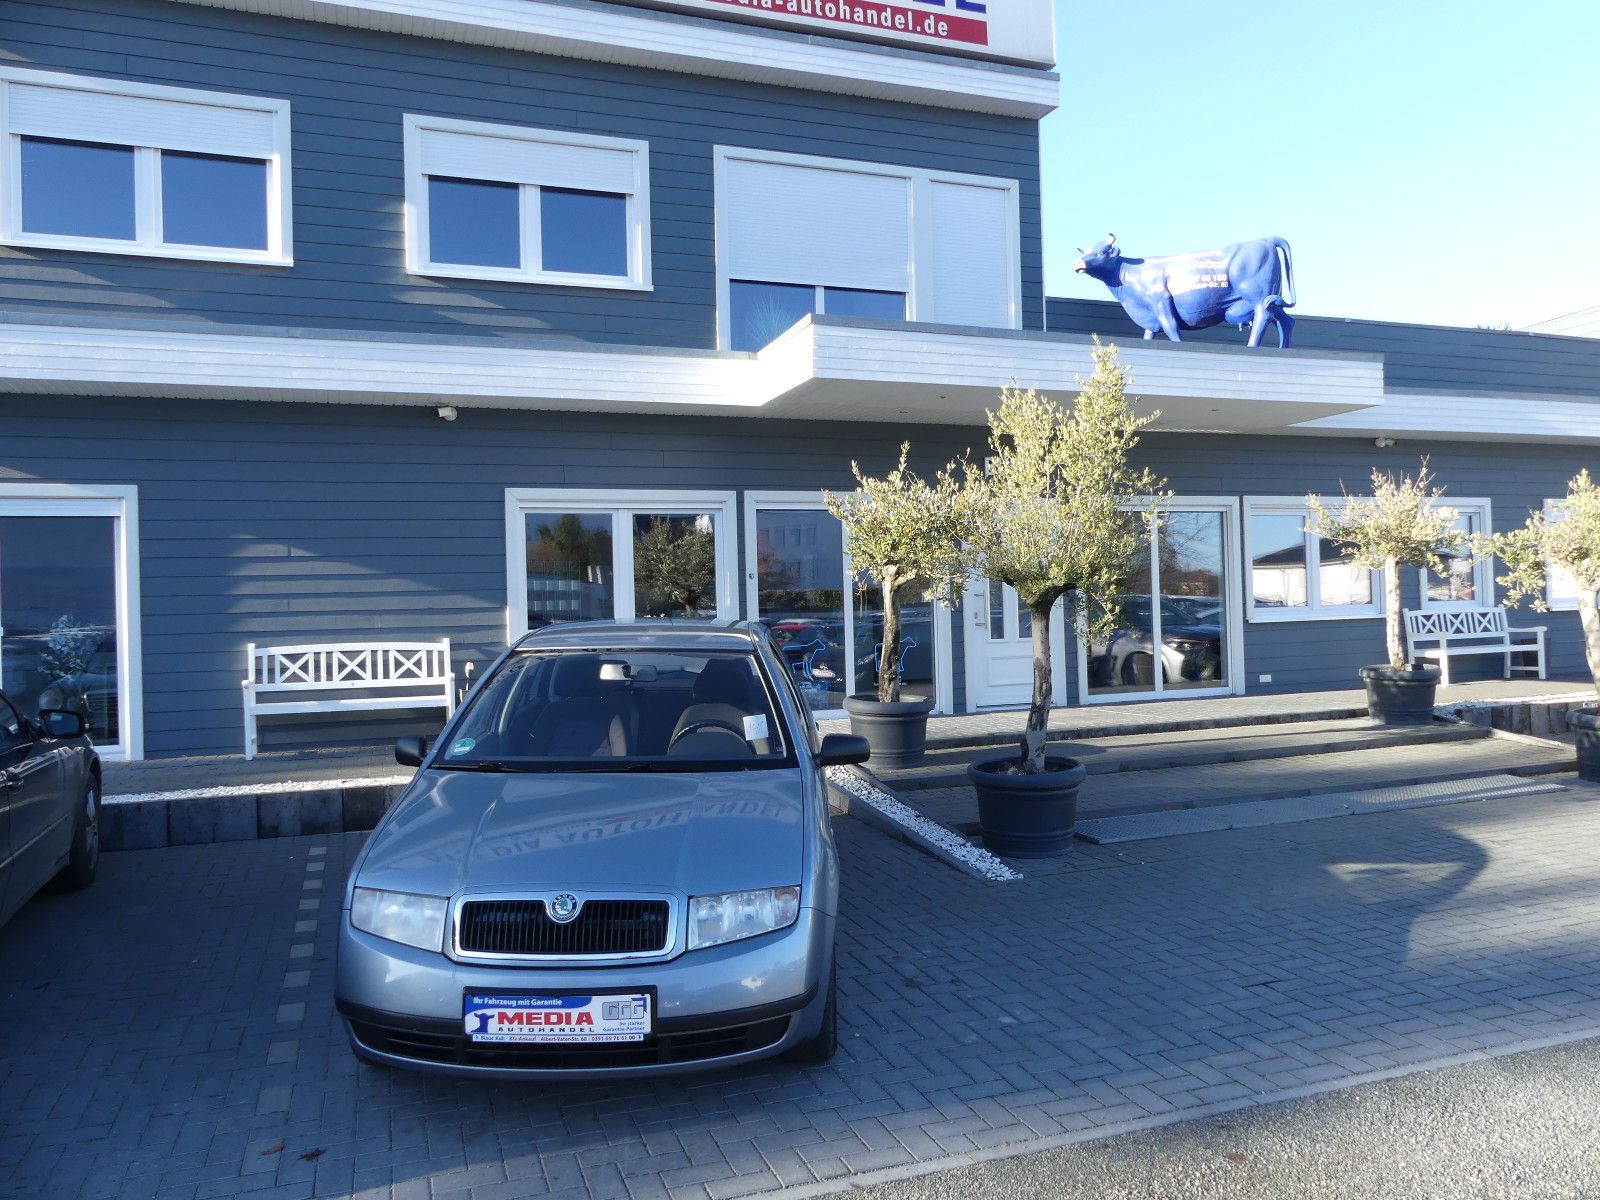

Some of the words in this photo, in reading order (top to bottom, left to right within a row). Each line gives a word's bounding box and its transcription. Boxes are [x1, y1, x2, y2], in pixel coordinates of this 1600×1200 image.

[484, 997, 517, 1007] Fahrzeug
[518, 998, 530, 1006] mit
[531, 998, 562, 1006] Garantie
[497, 1011, 594, 1026] MEDIA
